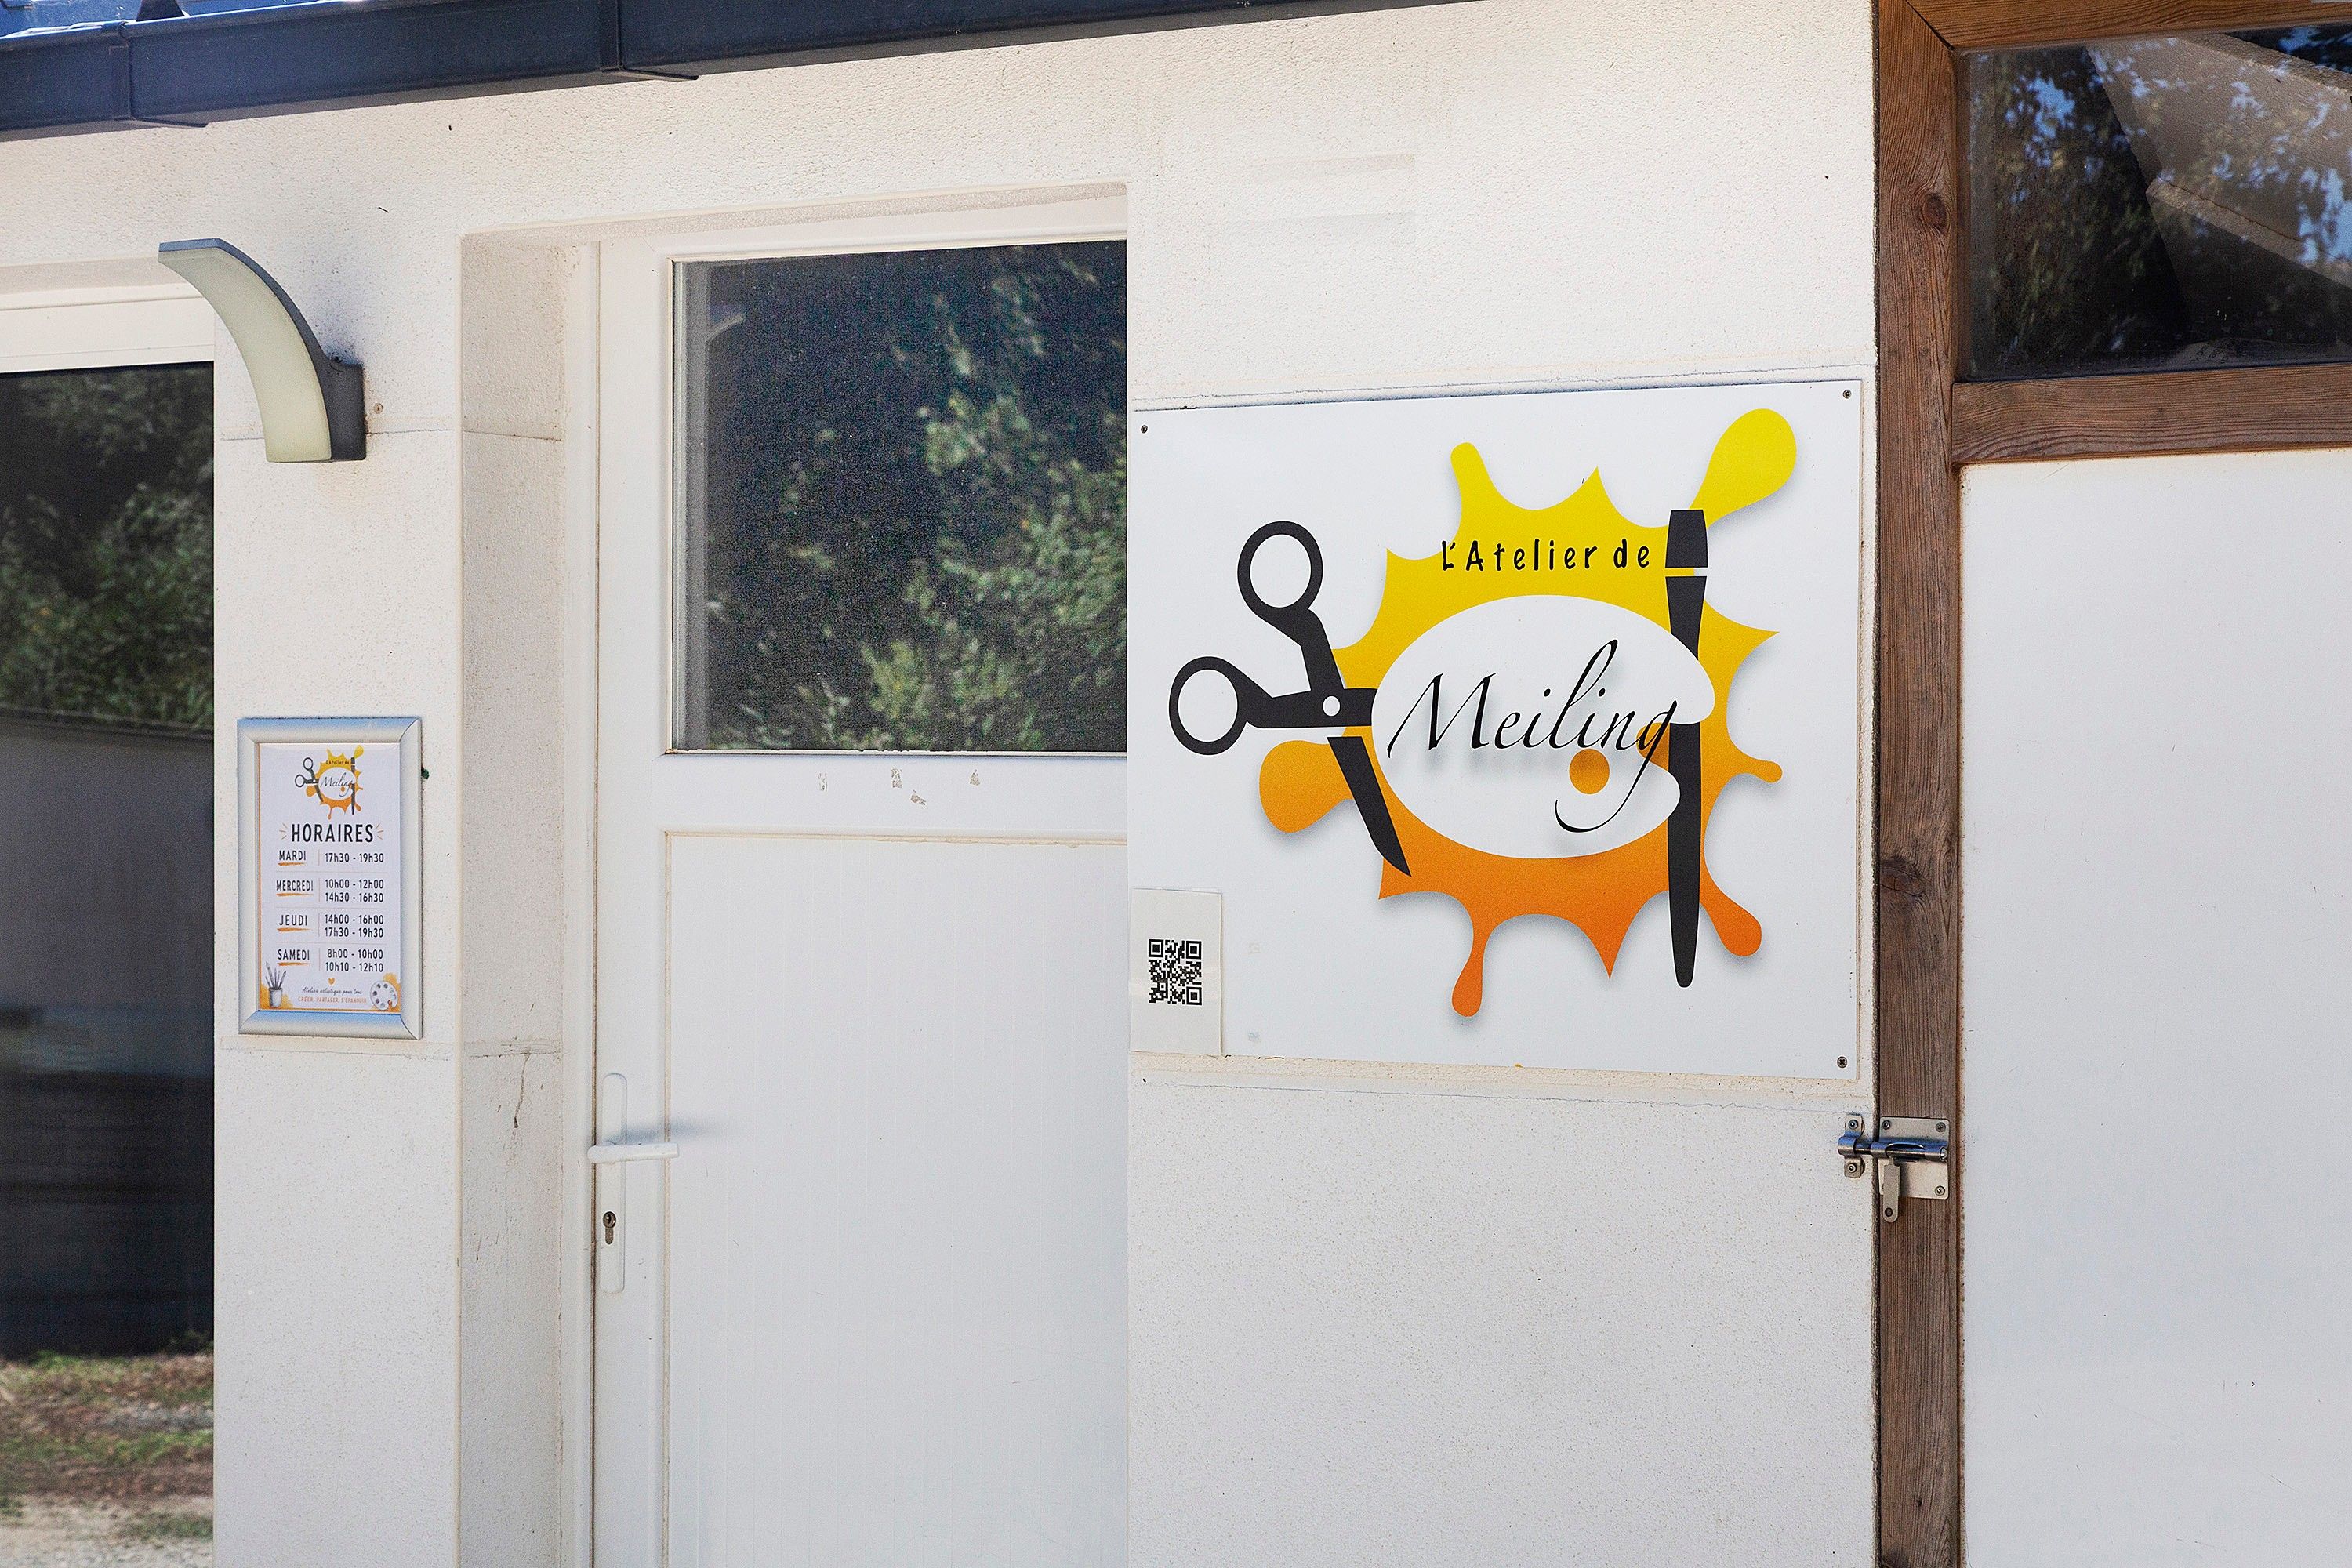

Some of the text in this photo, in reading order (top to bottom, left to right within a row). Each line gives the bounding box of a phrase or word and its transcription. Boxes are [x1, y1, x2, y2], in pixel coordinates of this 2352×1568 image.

[1613, 538, 1651, 570] de
[1387, 640, 1679, 834] Meiling
[320, 772, 354, 797] Meiling
[292, 823, 374, 843] HORAIRES
[279, 850, 307, 861] MARDI
[325, 852, 350, 863] 17h30
[358, 852, 385, 863] 19h30
[276, 880, 314, 891] MERCREDI
[325, 879, 350, 889] 10h00
[358, 879, 384, 889] 12h00
[325, 892, 350, 902] 14h30
[358, 892, 384, 902] 16h30
[279, 914, 307, 926] JEUDI
[324, 914, 350, 924] 14h00
[358, 914, 384, 925] 16h00
[324, 927, 350, 938] 17h30
[358, 927, 384, 938] 19h30
[278, 949, 310, 960] SAMEDI
[327, 949, 348, 959] 8h00
[358, 949, 383, 960] 10h00
[325, 962, 350, 972] 10h10
[359, 963, 383, 973] 12h10
